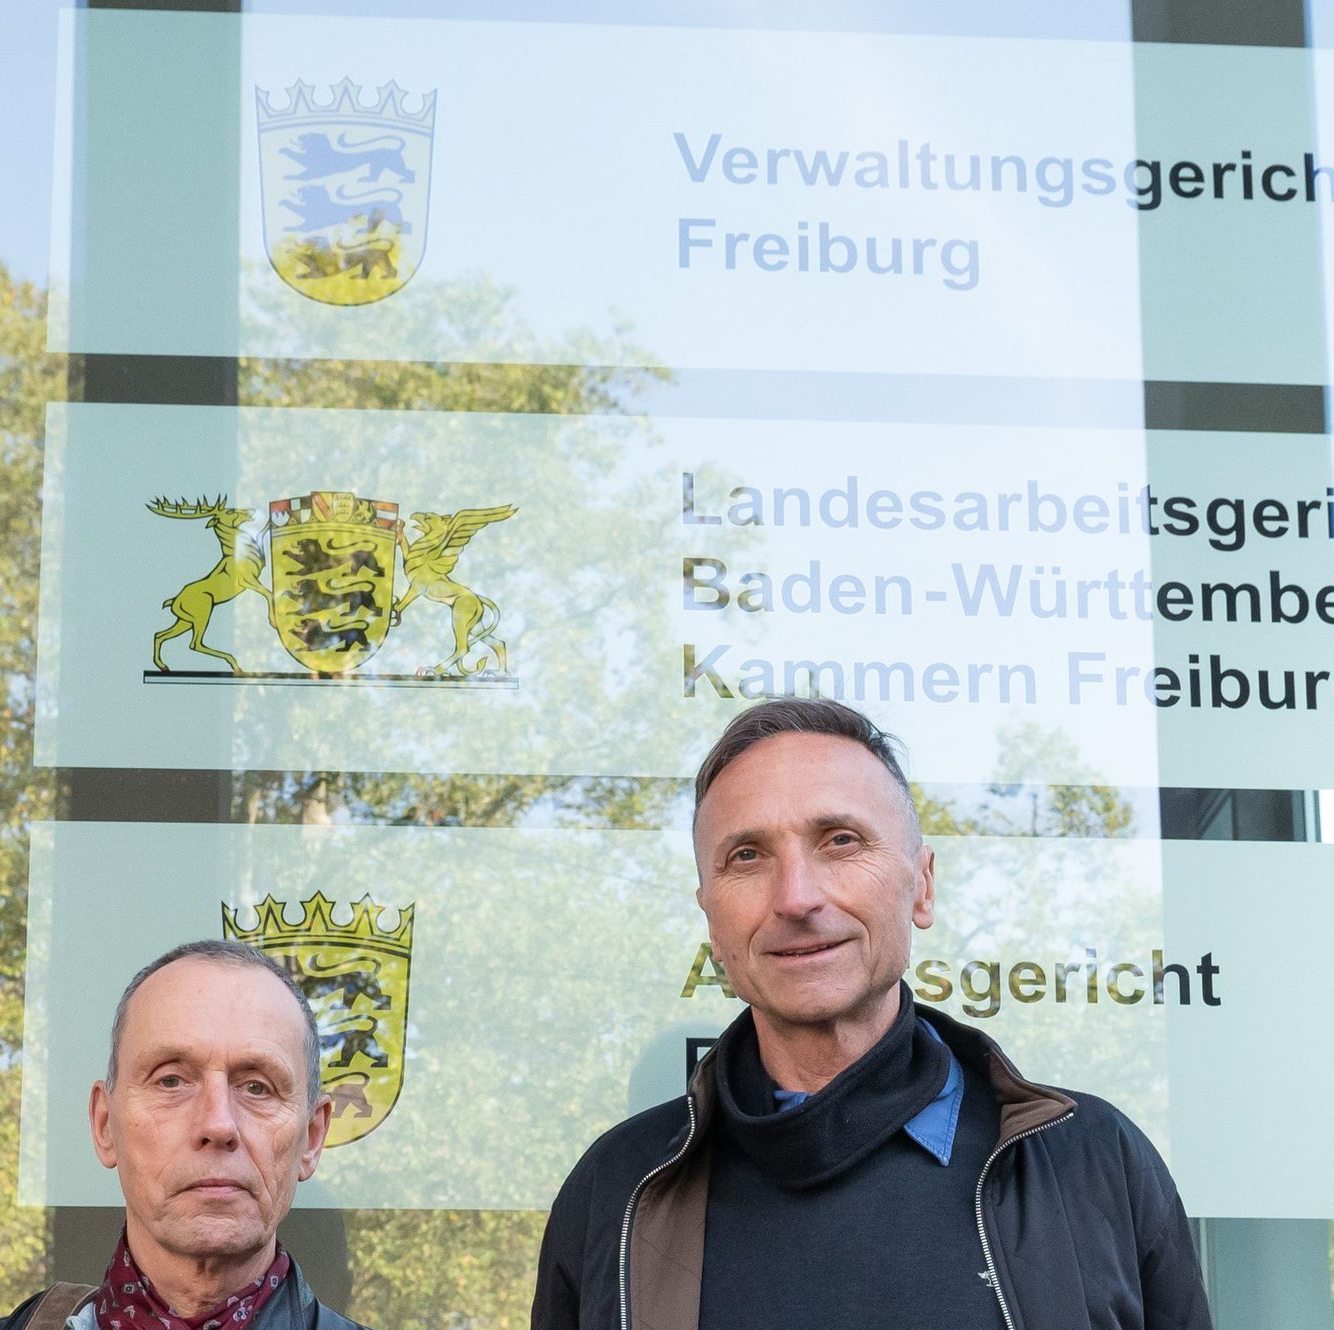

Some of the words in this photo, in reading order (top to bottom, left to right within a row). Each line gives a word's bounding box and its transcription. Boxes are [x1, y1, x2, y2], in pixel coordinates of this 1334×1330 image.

[677, 217, 982, 292] Freiburg
[681, 643, 1038, 706] Kammern
[680, 942, 1222, 1018] Asgericht
